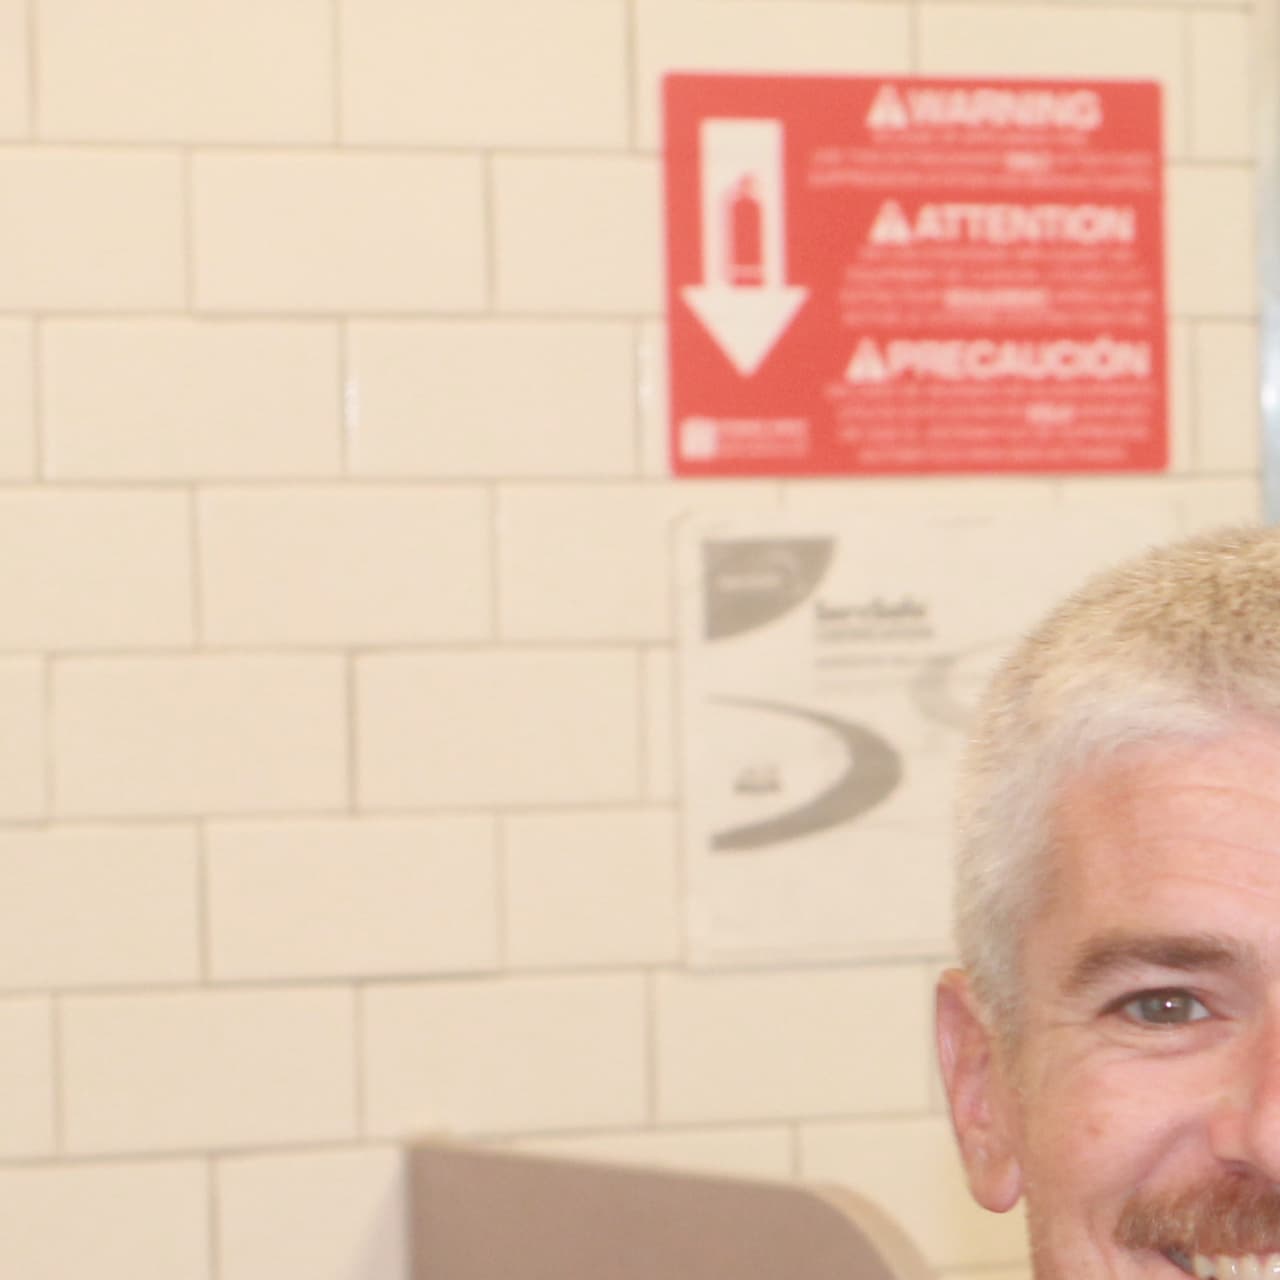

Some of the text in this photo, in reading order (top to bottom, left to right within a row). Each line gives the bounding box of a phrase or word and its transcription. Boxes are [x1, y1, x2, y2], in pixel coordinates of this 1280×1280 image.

[907, 89, 1102, 130] WARNING
[913, 202, 1136, 244] ATTENTION
[886, 330, 1151, 380] PRECAUCIÓN
